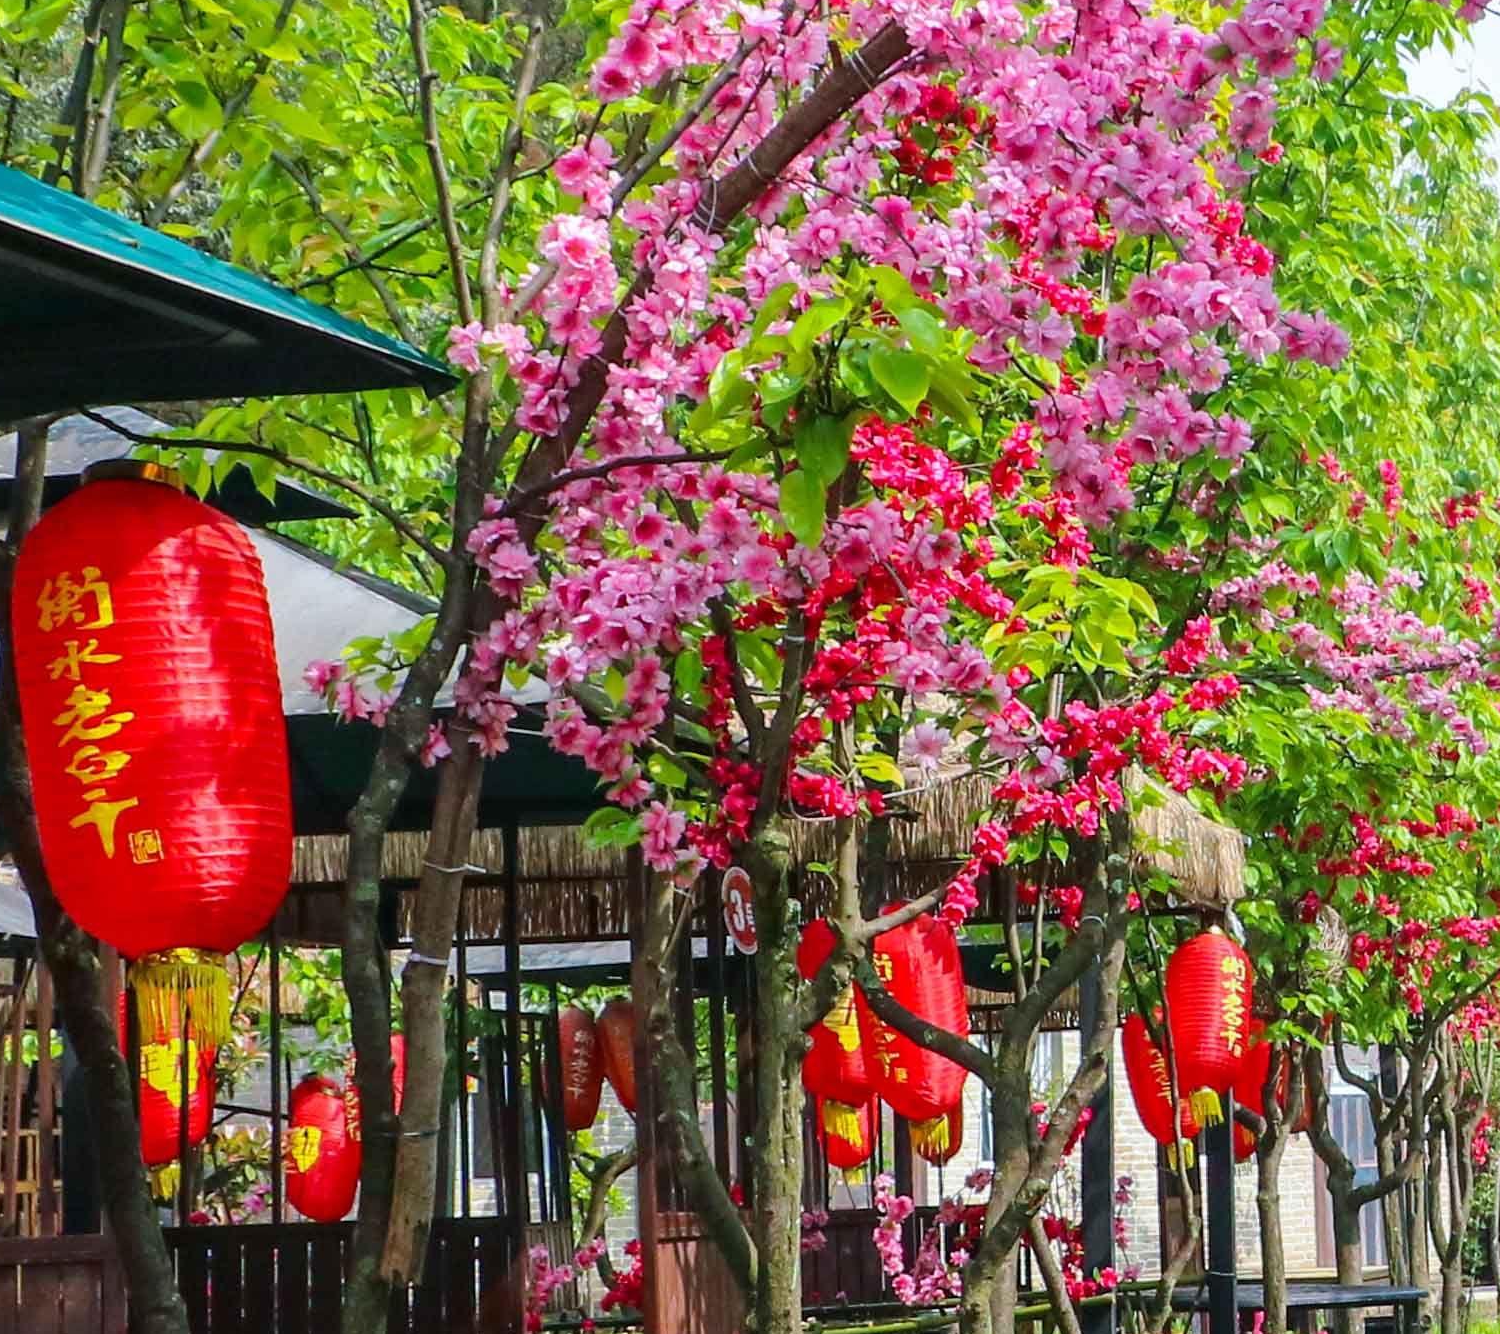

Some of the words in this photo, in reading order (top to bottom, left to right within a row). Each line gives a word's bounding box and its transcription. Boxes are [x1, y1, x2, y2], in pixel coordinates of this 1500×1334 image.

[36, 565, 139, 860] 衡水老白干
